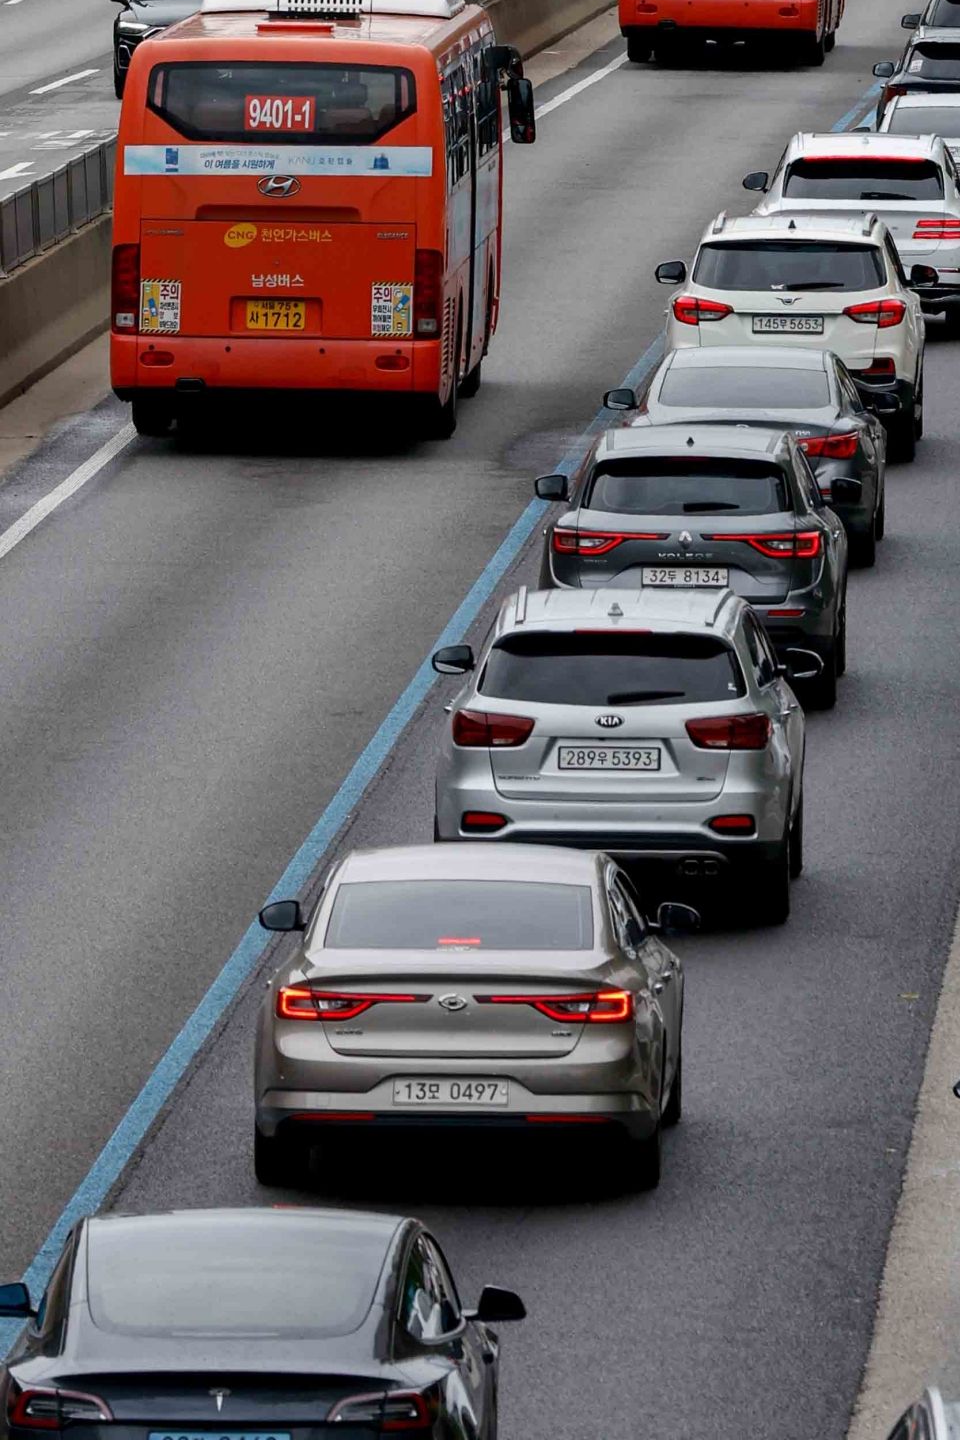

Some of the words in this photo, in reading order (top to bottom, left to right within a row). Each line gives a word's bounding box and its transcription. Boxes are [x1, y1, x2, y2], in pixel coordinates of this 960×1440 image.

[249, 99, 311, 129] 9401-1
[204, 160, 212, 168] 이
[215, 160, 240, 169] 여름을
[242, 160, 275, 169] 시원하게
[227, 231, 255, 240] CNG
[261, 229, 332, 242] 천연가스버스
[251, 274, 304, 287] 남성버스
[160, 284, 179, 300] 주의
[373, 287, 392, 302] 주의
[249, 311, 259, 323] 사
[263, 312, 301, 328] 1712
[790, 319, 819, 330] 5653
[684, 570, 719, 582] 8134
[600, 717, 621, 726] KIA
[567, 750, 608, 766] 289우
[612, 751, 653, 766] 5393
[404, 1083, 440, 1100] 13모
[450, 1083, 498, 1100] 0497
